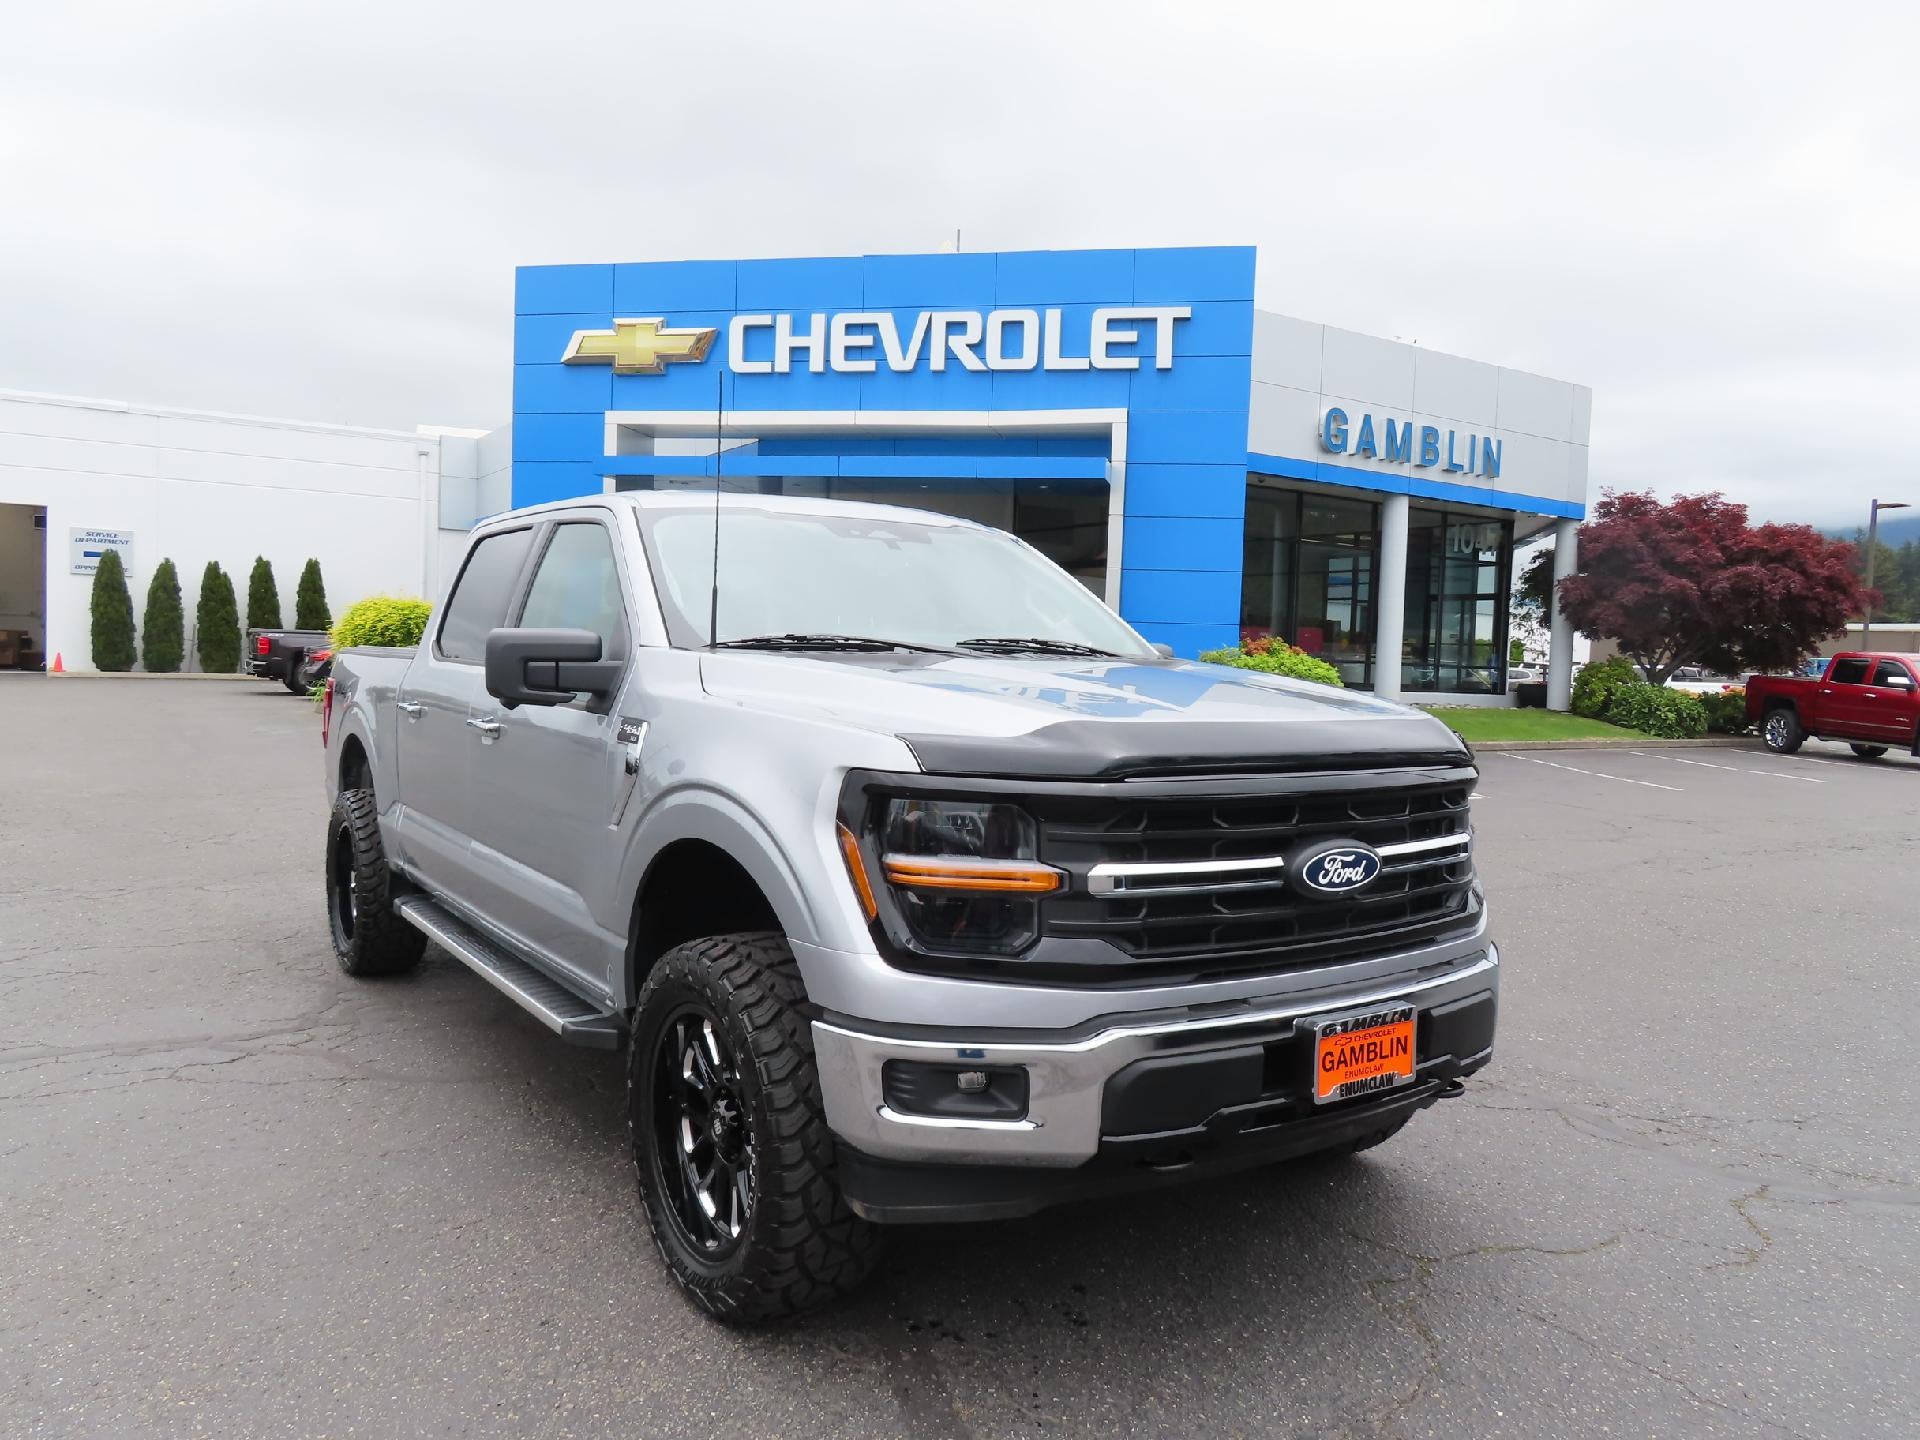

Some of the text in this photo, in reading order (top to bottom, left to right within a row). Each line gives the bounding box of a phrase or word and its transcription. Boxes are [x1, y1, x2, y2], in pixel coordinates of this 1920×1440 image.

[728, 307, 1192, 374] CHEVROLET
[1322, 407, 1502, 478] GAMBLIN
[1318, 854, 1367, 885] Ford
[1354, 1027, 1397, 1042] CHEVROLET
[1321, 1035, 1408, 1073] GAMBLIN
[1340, 1071, 1396, 1098] ENUMCLAW
[1344, 1063, 1384, 1080] ENUMCLAW
